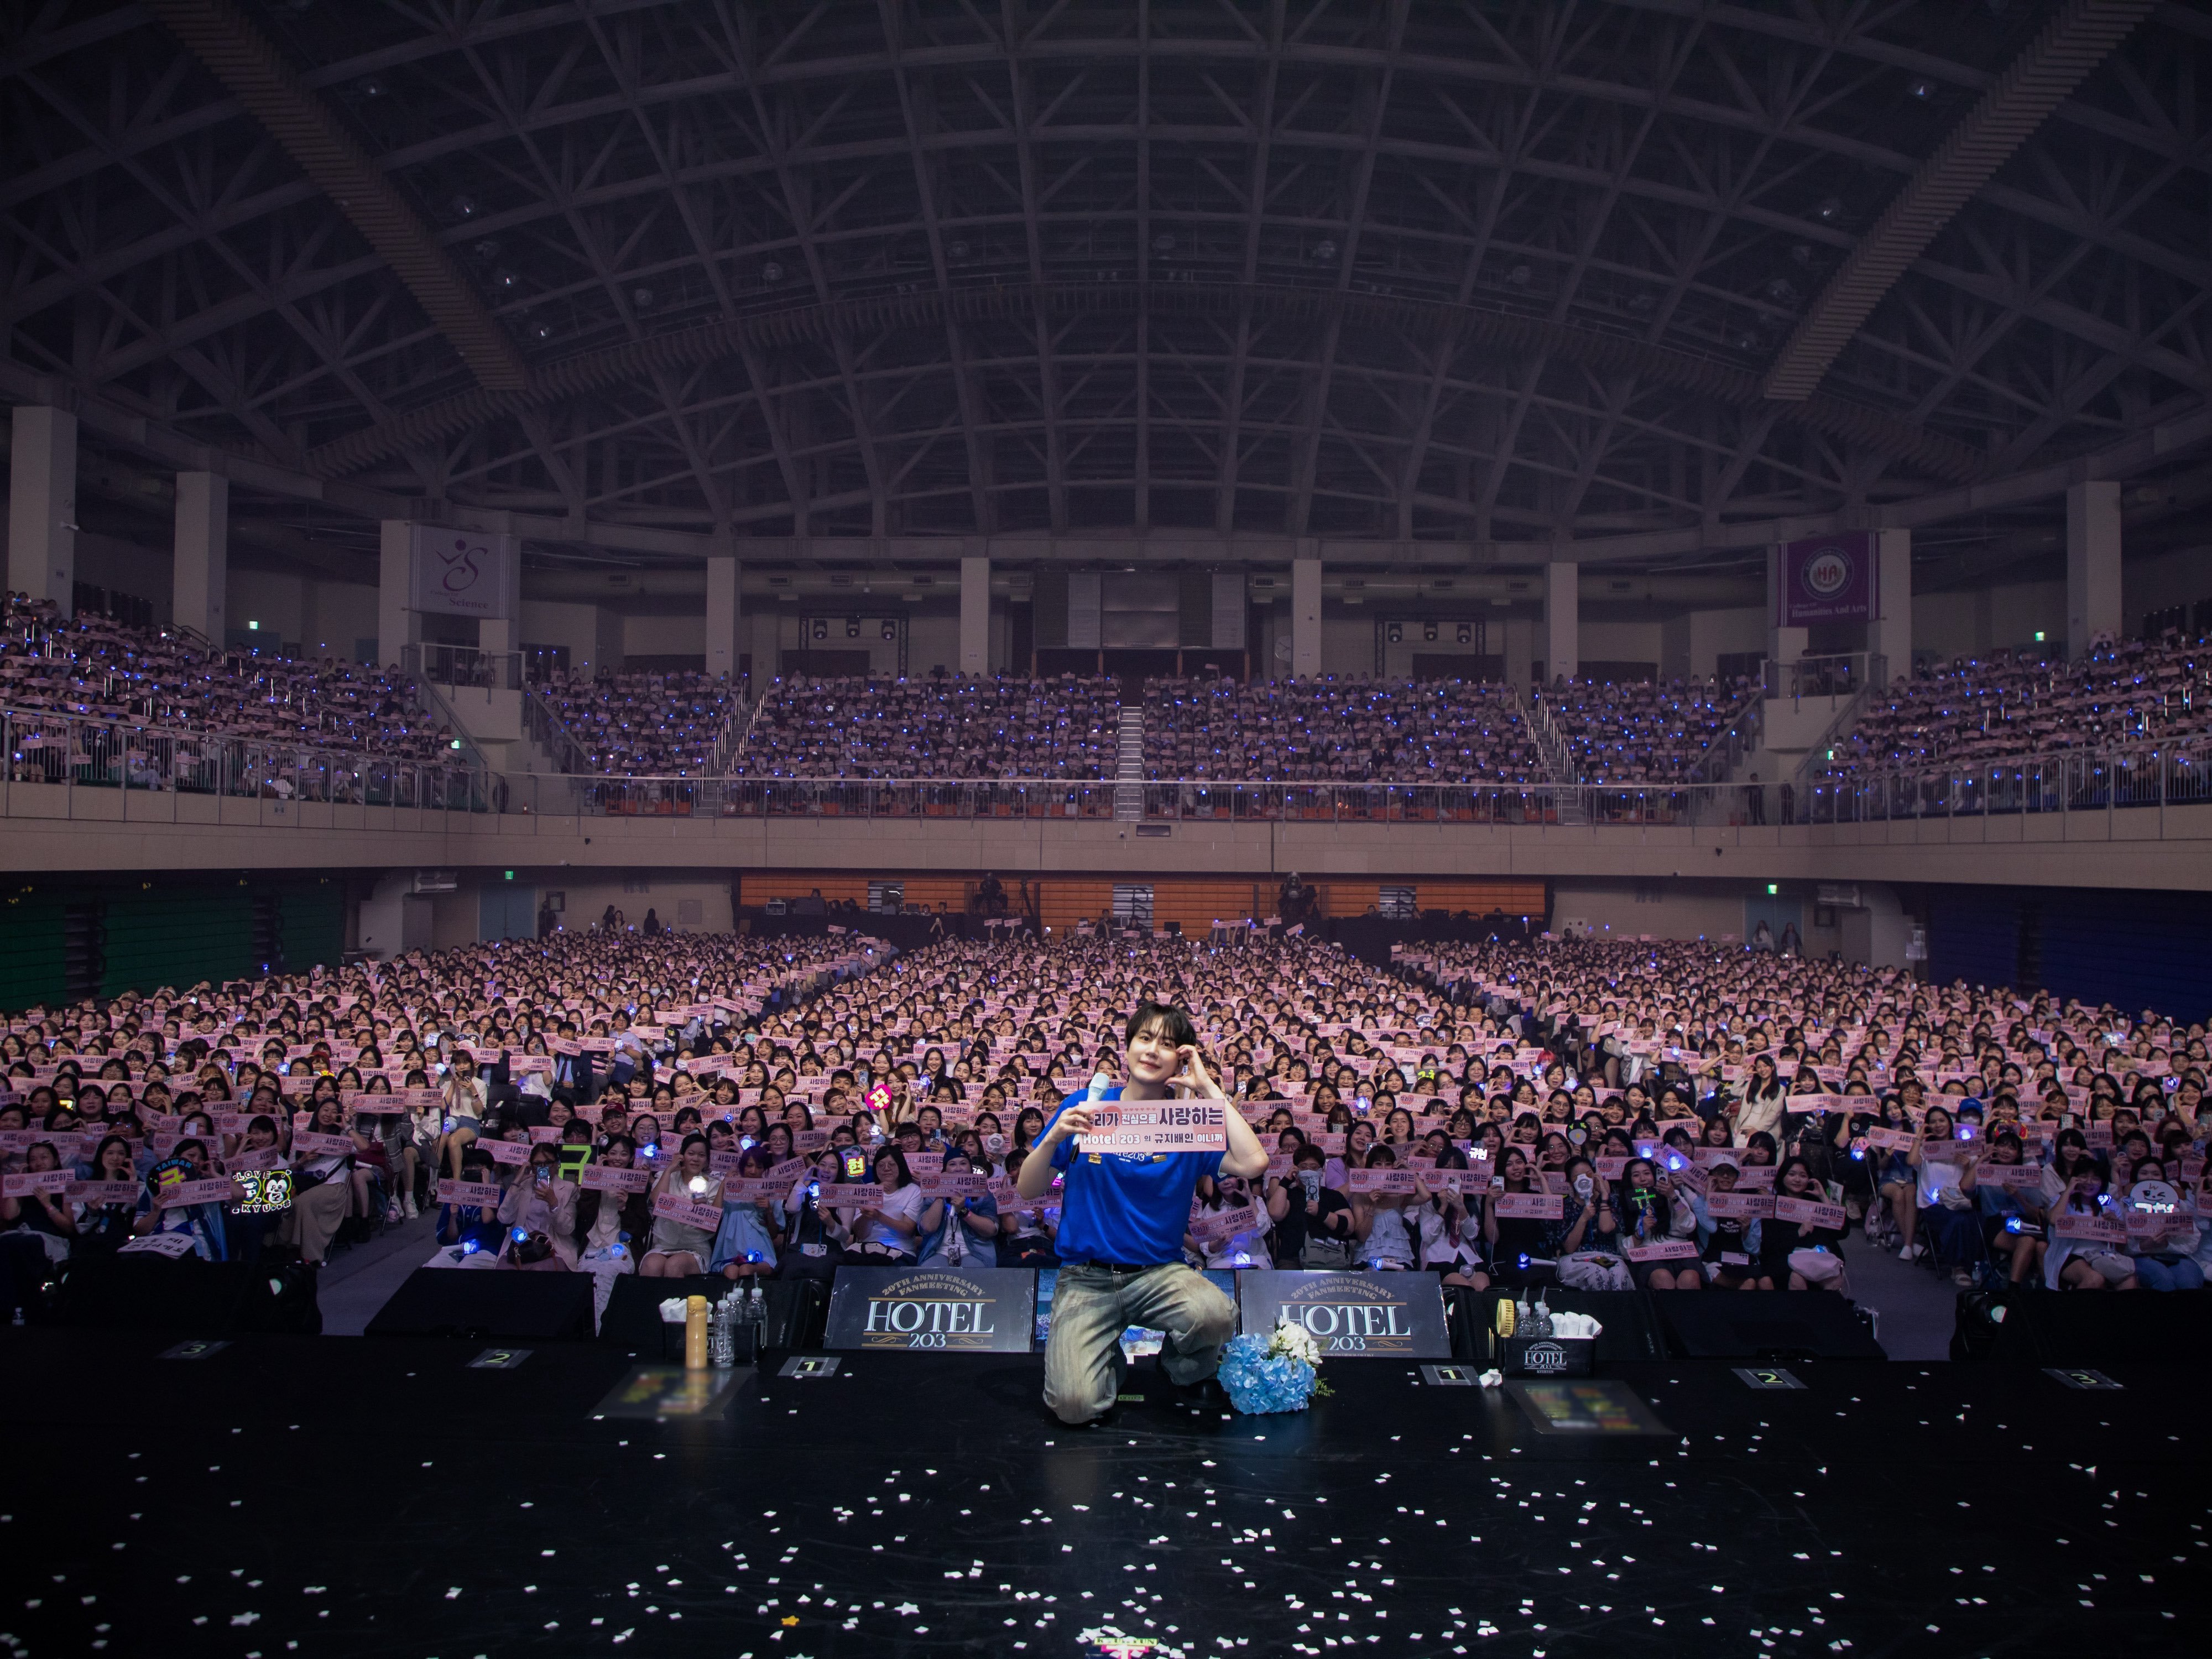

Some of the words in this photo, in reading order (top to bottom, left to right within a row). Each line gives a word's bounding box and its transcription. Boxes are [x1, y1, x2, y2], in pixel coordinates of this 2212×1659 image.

[448, 598, 488, 609] Science
[1792, 608, 1832, 617] Humanities
[1835, 604, 1849, 614] And
[1851, 603, 1867, 613] Arts
[1121, 1113, 1157, 1125] 진심으로
[1159, 1107, 1223, 1126] 사랑하는
[1083, 1133, 1116, 1145] Hotel
[1120, 1134, 1141, 1145] 203
[1154, 1133, 1193, 1144] 규지배인
[1197, 1134, 1223, 1142] 이니까
[155, 1159, 192, 1172] TAIWAN
[847, 1157, 864, 1176] 현
[236, 1171, 271, 1181] LOVE
[584, 1169, 602, 1178] 우리가
[619, 1172, 648, 1182] 사랑하는
[957, 1177, 987, 1186] 사랑하는
[1386, 1172, 1415, 1182] 사랑하는
[471, 1185, 499, 1197] 사랑하는
[760, 1181, 790, 1190] 사랑하는
[854, 1187, 883, 1197] 사랑하는
[241, 1203, 271, 1213] KYU
[1745, 1197, 1774, 1207] 사랑하는
[658, 1197, 675, 1208] 우리가
[691, 1204, 721, 1220] 사랑하는
[1813, 1205, 1844, 1219] 사랑하는
[655, 1207, 671, 1215] Hotel
[686, 1215, 704, 1225] 규지배인
[1192, 1224, 1208, 1234] 우리가
[1223, 1209, 1254, 1225] 사랑하는
[882, 1277, 911, 1296] 20TH
[912, 1274, 986, 1297] ANNIVERSARY
[898, 1281, 968, 1297] FANMEETING
[1291, 1281, 1317, 1300] 20TH
[1319, 1277, 1395, 1300] ANNIVERSARY
[1307, 1285, 1378, 1300] FANMEETING
[864, 1301, 994, 1333] HOTEL
[1282, 1305, 1411, 1335] HOTEL
[909, 1333, 946, 1348] 203
[1329, 1336, 1366, 1350] 203
[1538, 1342, 1563, 1350] ANNIVERSARY
[181, 1343, 206, 1354] 3
[485, 1353, 510, 1363] 2
[1525, 1352, 1567, 1364] HOTEL
[804, 1361, 816, 1371] 1
[1442, 1369, 1457, 1380] 1
[1757, 1373, 1783, 1384] 2
[2070, 1373, 2098, 1385] 3
